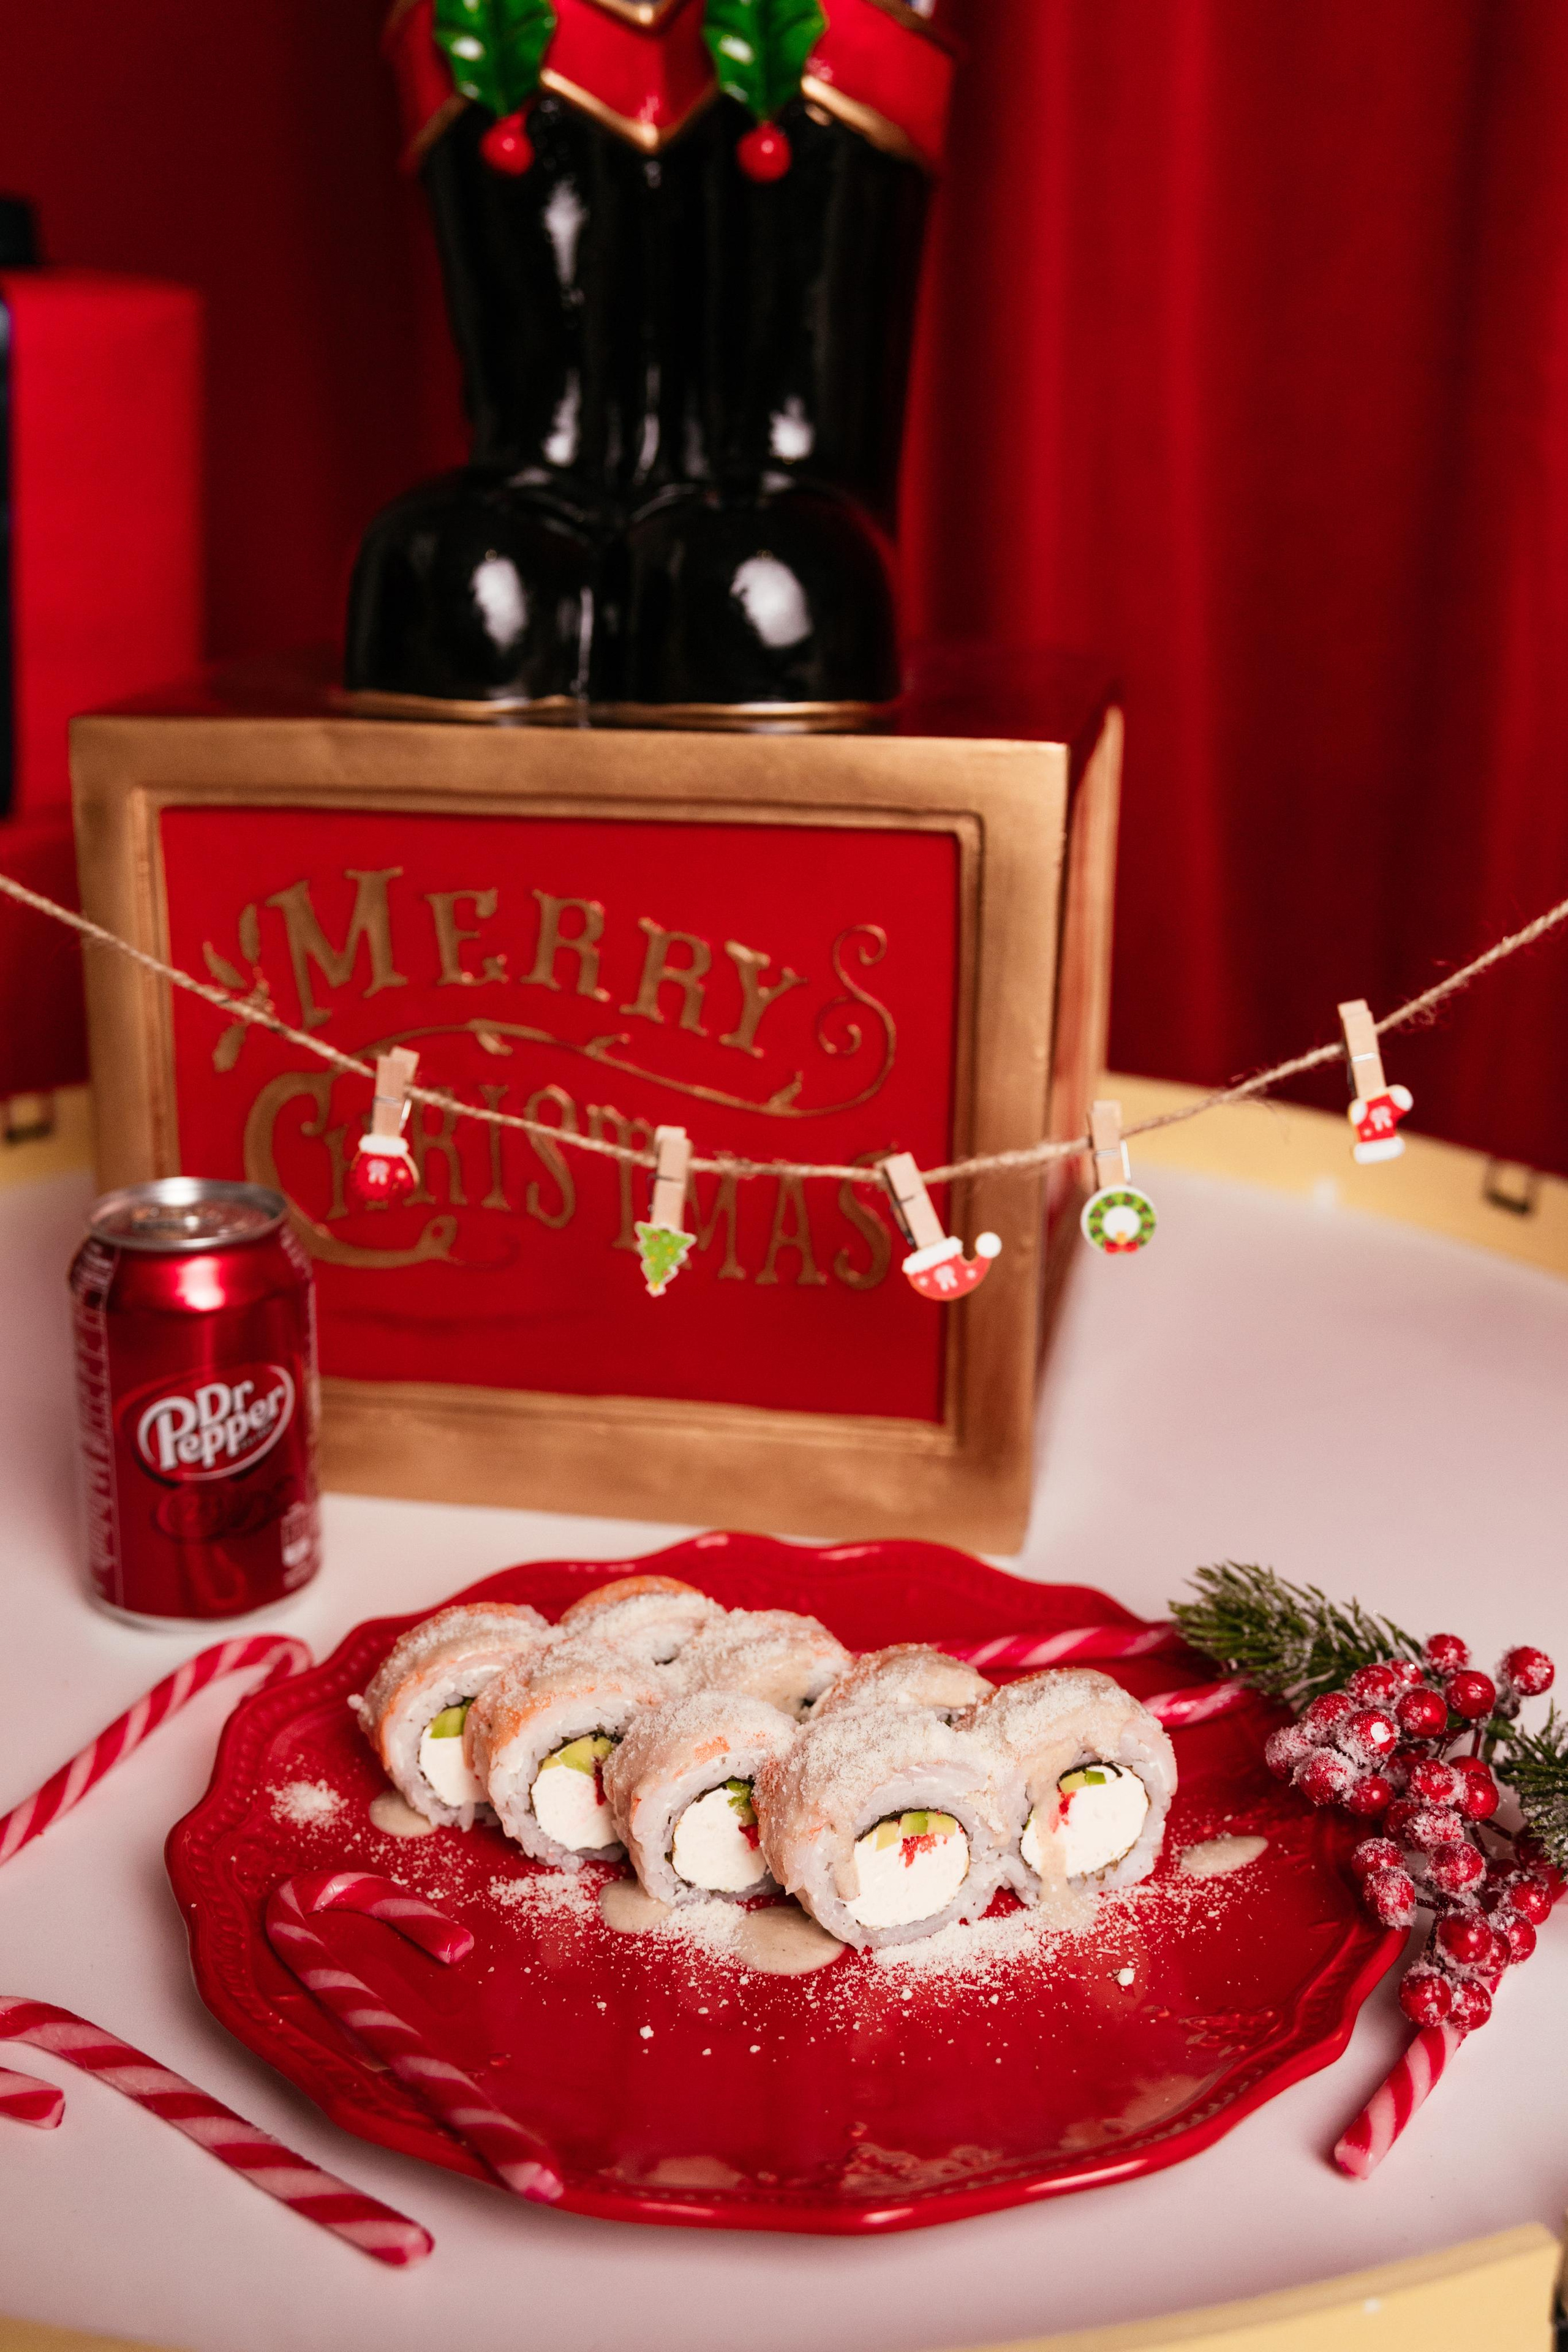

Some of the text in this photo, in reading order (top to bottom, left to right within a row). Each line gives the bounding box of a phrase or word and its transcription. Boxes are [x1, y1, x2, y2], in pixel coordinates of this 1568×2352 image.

[266, 865, 809, 1058] MERRY
[138, 1384, 285, 1471] Pepper
[195, 1379, 255, 1428] Dr
